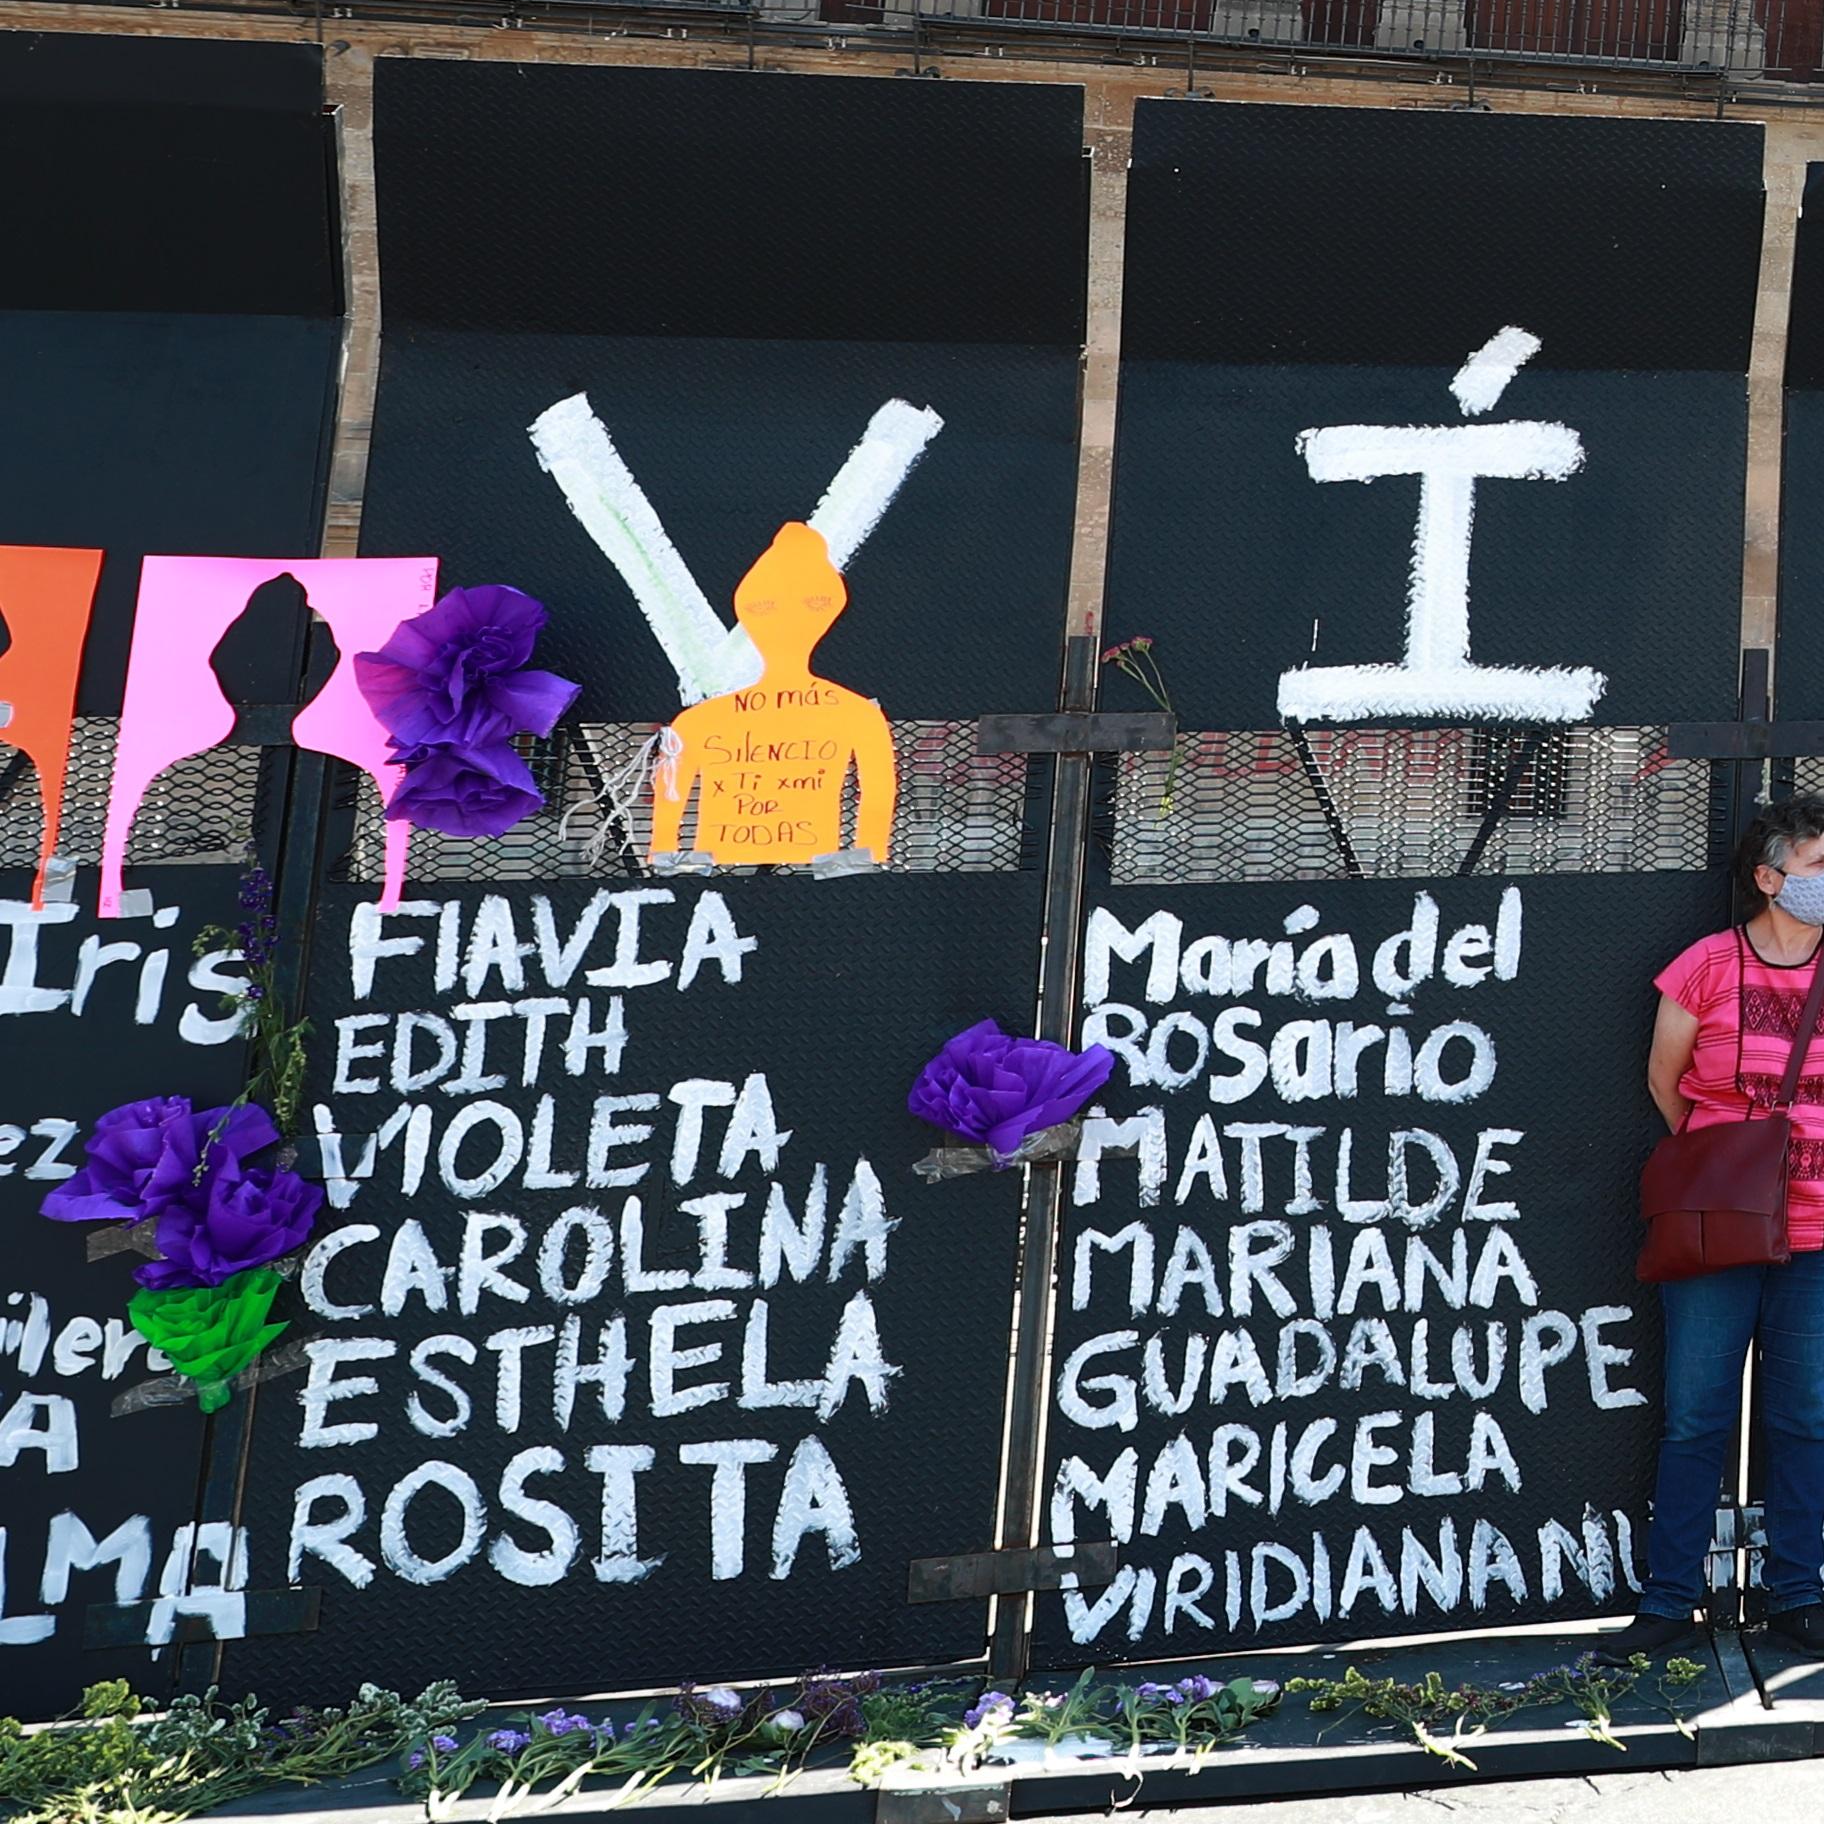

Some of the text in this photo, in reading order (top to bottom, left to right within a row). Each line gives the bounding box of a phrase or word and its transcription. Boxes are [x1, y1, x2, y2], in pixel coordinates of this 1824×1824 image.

[712, 821, 818, 845] TODAS
[1081, 884, 1523, 1010] María del
[333, 995, 629, 1096] EDITH
[312, 1072, 793, 1211] VIOLETA
[1072, 1105, 1525, 1231] MATILDE
[300, 1154, 900, 1320] CAROLINA
[1071, 1219, 1538, 1321] MARIANA
[296, 1291, 902, 1451] ESTHELA
[1056, 1304, 1648, 1432] GUADALUPE
[286, 1435, 861, 1589] ROSITA
[1050, 1410, 1521, 1557] MARICELA
[1060, 1515, 1528, 1644] VIRIDIANA
